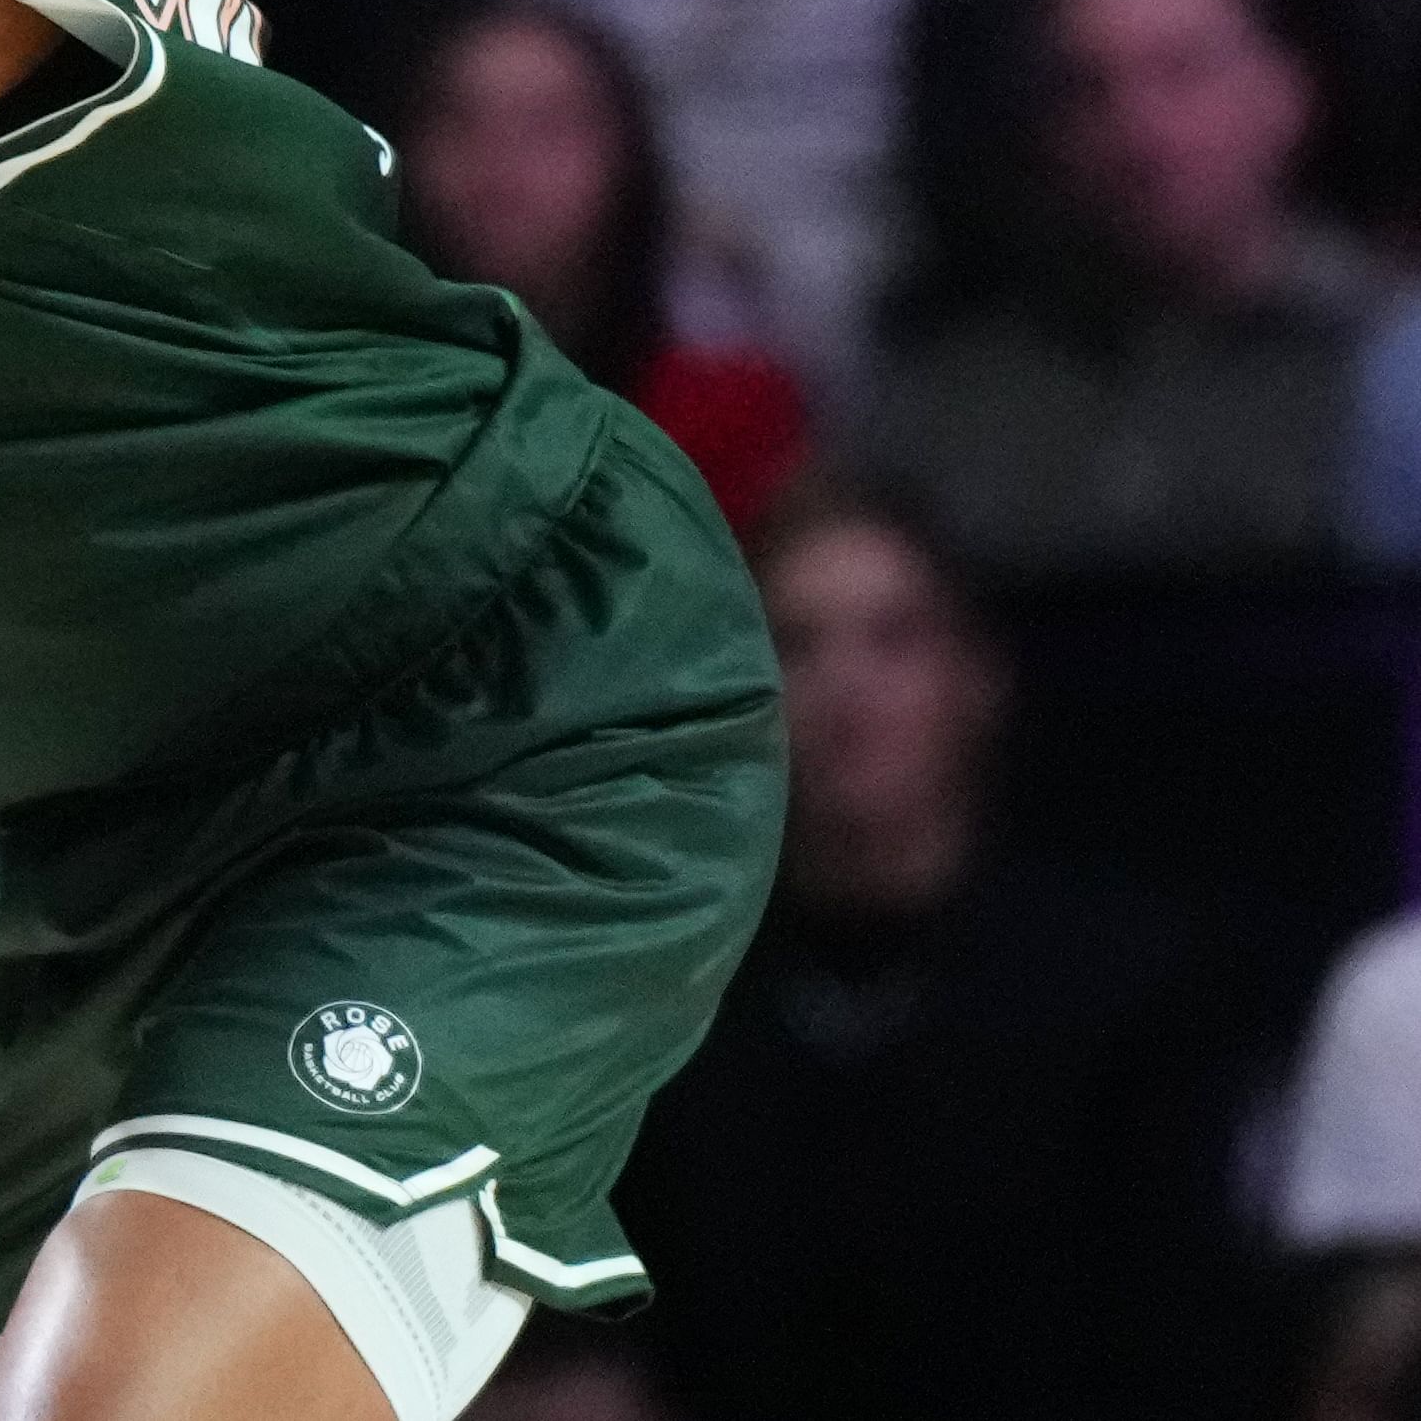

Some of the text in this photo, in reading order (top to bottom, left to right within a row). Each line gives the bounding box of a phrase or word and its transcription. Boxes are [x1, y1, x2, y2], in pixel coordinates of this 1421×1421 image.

[320, 1007, 409, 1051] ROSE
[303, 1042, 405, 1104] BASKETBALL CLUB
